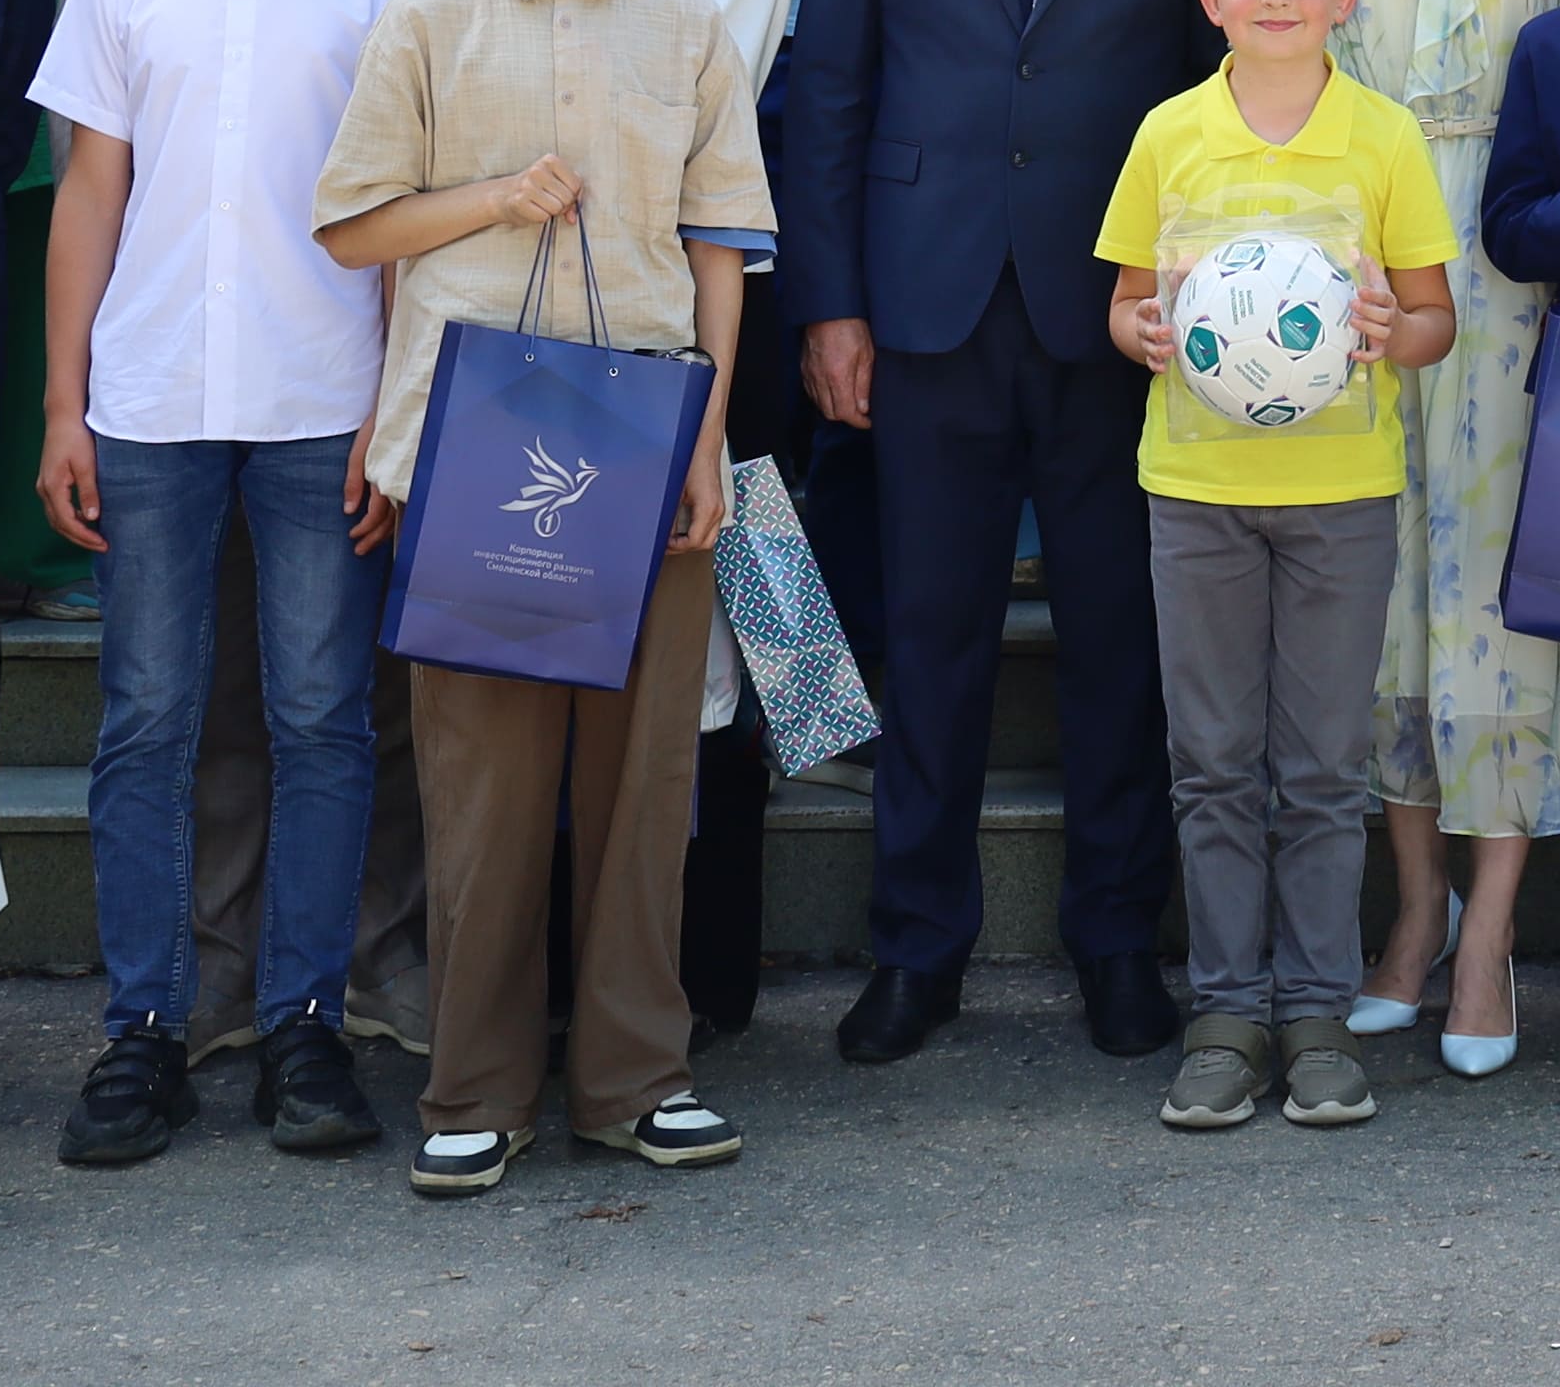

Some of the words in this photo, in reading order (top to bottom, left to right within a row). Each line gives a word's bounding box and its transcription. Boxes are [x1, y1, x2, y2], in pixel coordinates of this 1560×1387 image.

[472, 549, 553, 569] инвестиционного
[553, 562, 595, 577] развития
[508, 543, 564, 560] Корпорация
[486, 560, 541, 579] Смоленской
[542, 570, 579, 584] области
